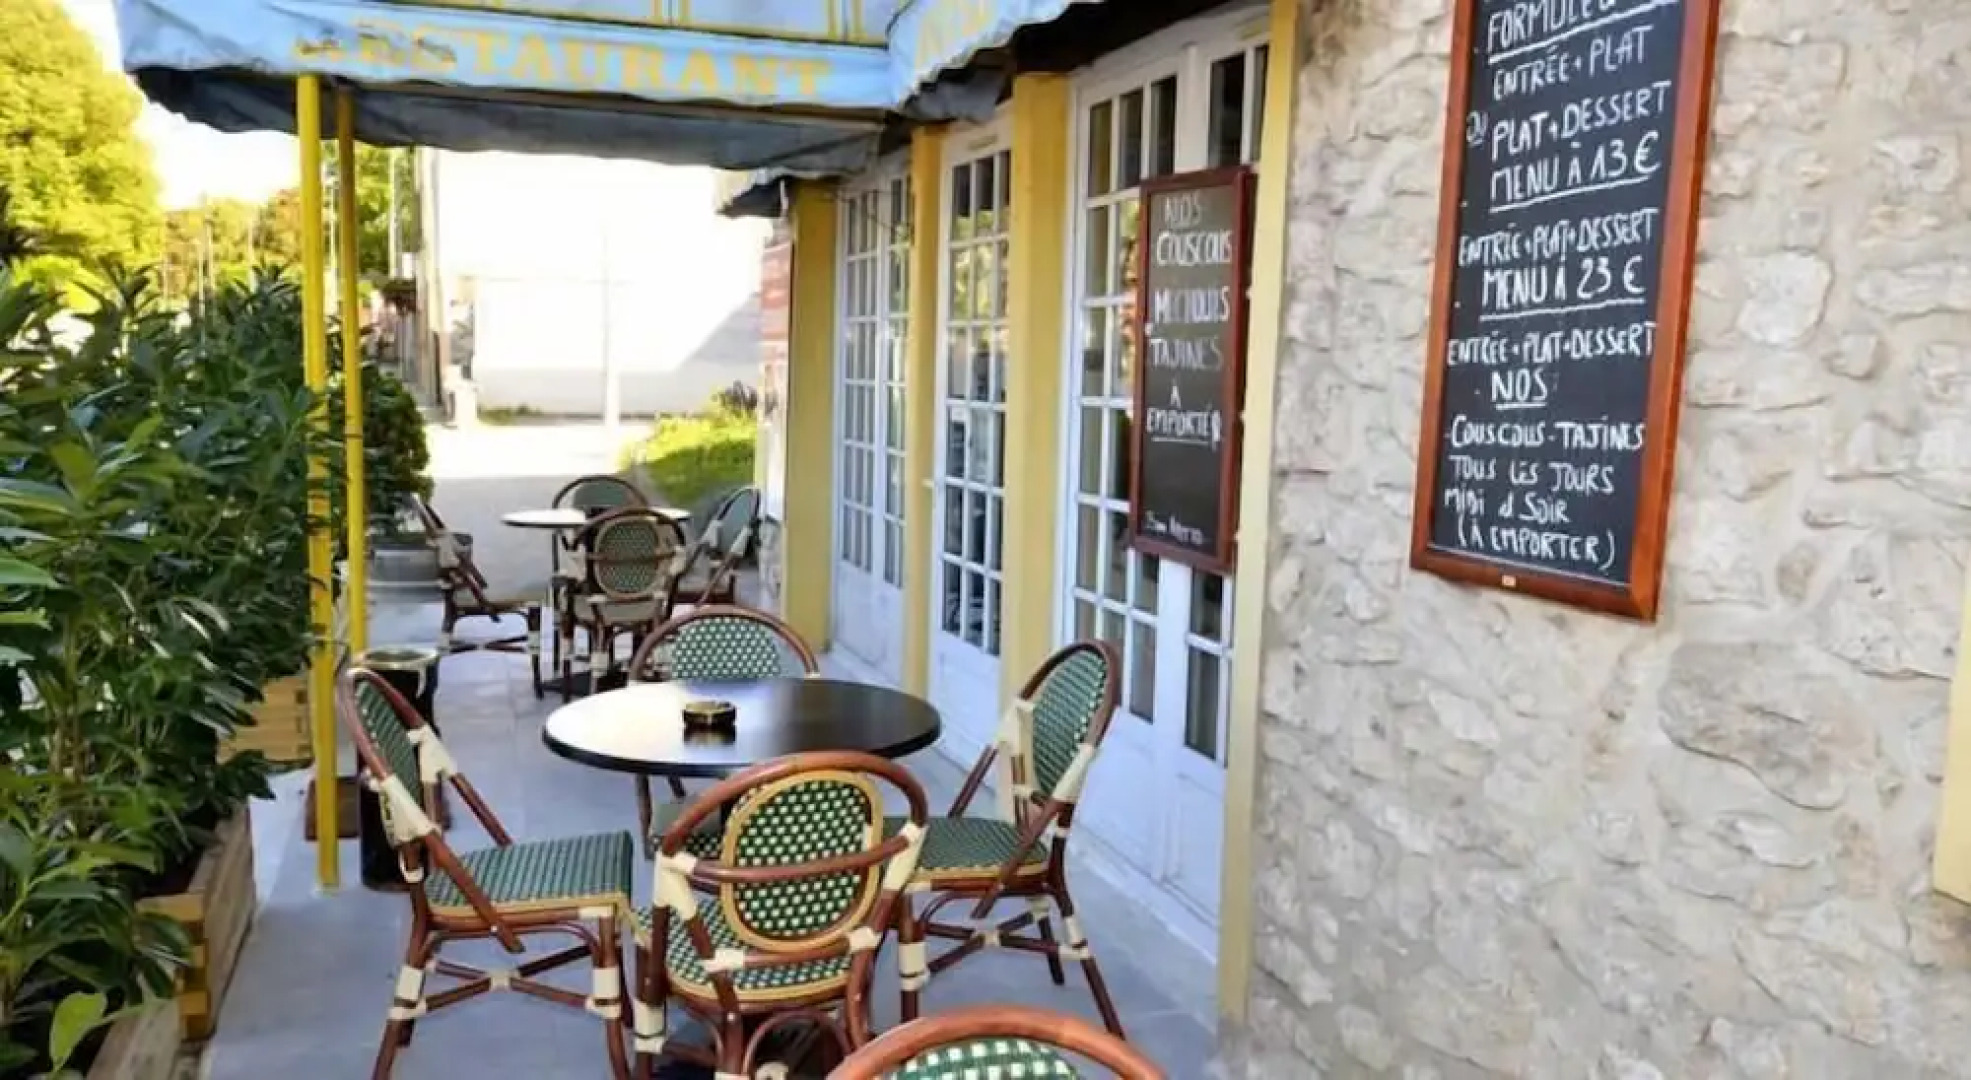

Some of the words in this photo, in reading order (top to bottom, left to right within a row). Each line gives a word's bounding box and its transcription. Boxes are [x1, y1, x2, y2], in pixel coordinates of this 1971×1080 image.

[1491, 154, 1560, 201] MENU
[1634, 130, 1661, 173] €
[1165, 192, 1202, 227] NOS
[1157, 229, 1232, 267] COUSCOUS
[1483, 265, 1548, 310] MENU
[1577, 256, 1612, 299] 23
[1624, 255, 1646, 294] €
[1491, 367, 1549, 403] NOS
[1448, 454, 1497, 481] TOUS
[1549, 461, 1615, 496] JOURS
